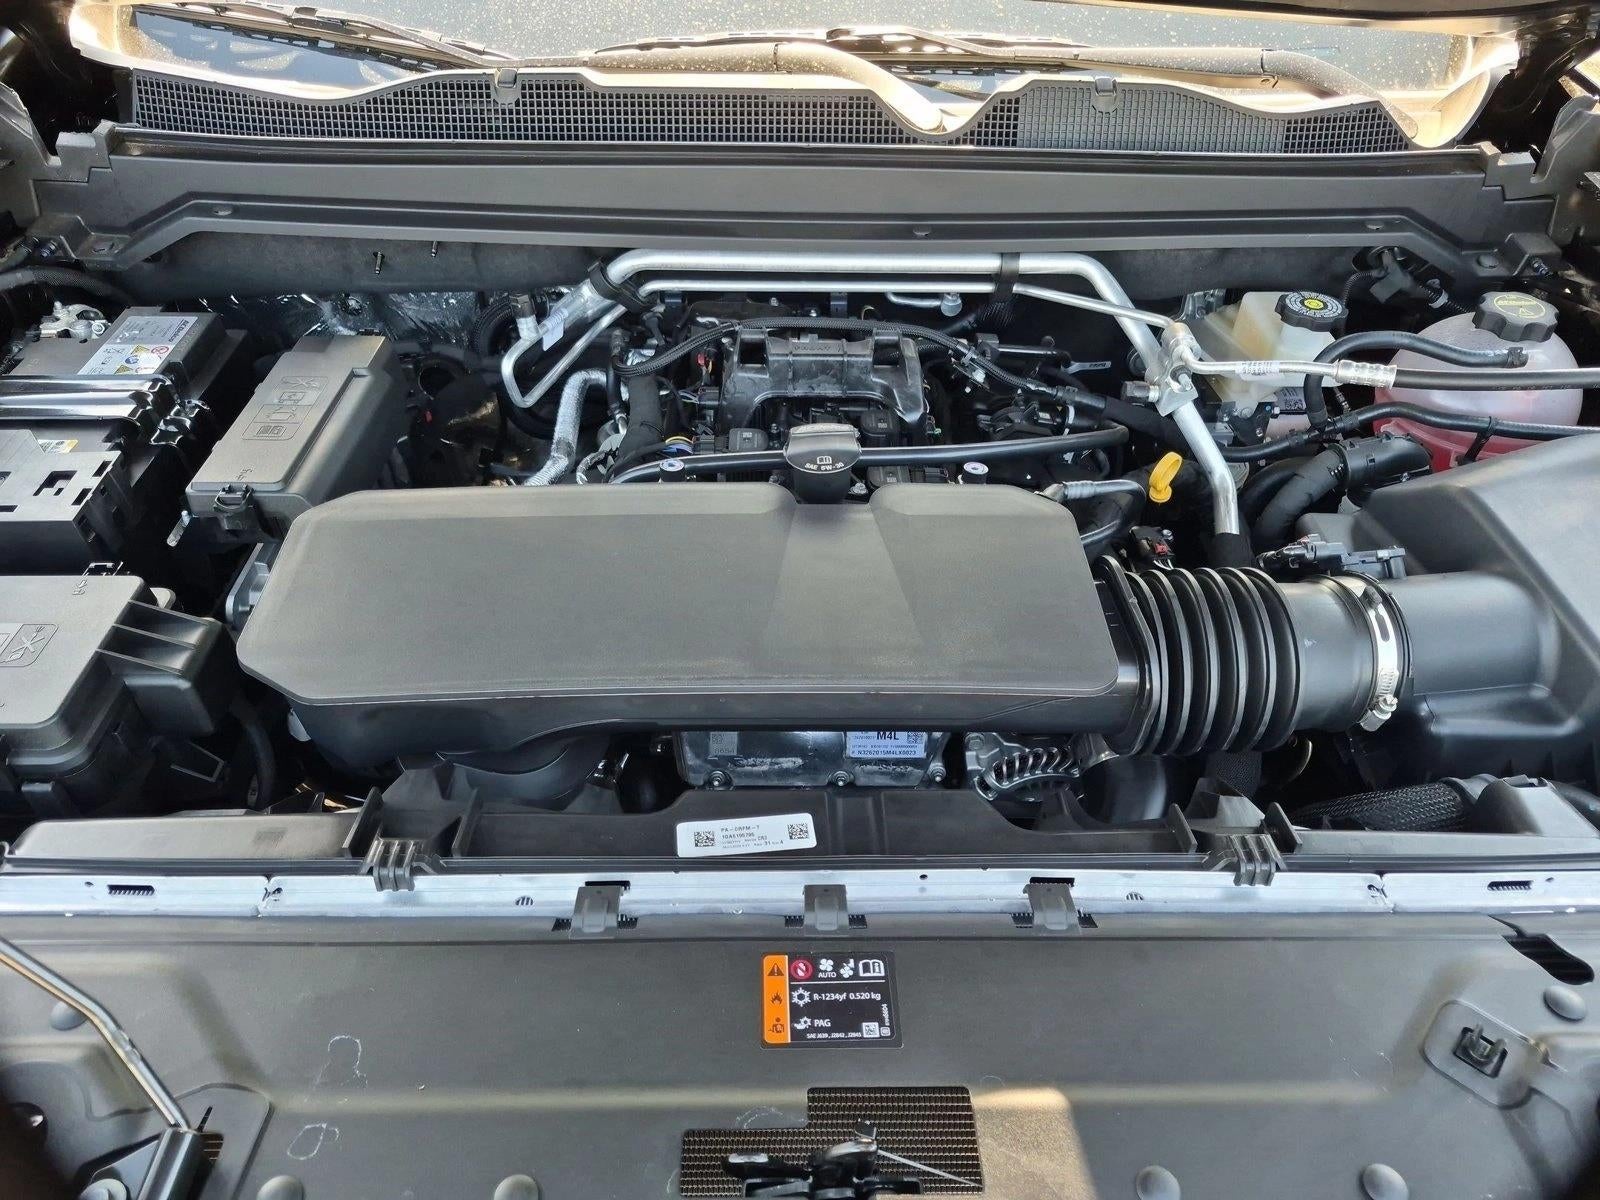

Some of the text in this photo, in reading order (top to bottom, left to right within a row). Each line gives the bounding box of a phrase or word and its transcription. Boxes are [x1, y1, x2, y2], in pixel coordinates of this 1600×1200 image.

[804, 462, 818, 471] SAE
[876, 731, 899, 740] M4L
[813, 993, 847, 1001] R-1234yf
[871, 992, 881, 1001] kg
[814, 1019, 831, 1027] PAG
